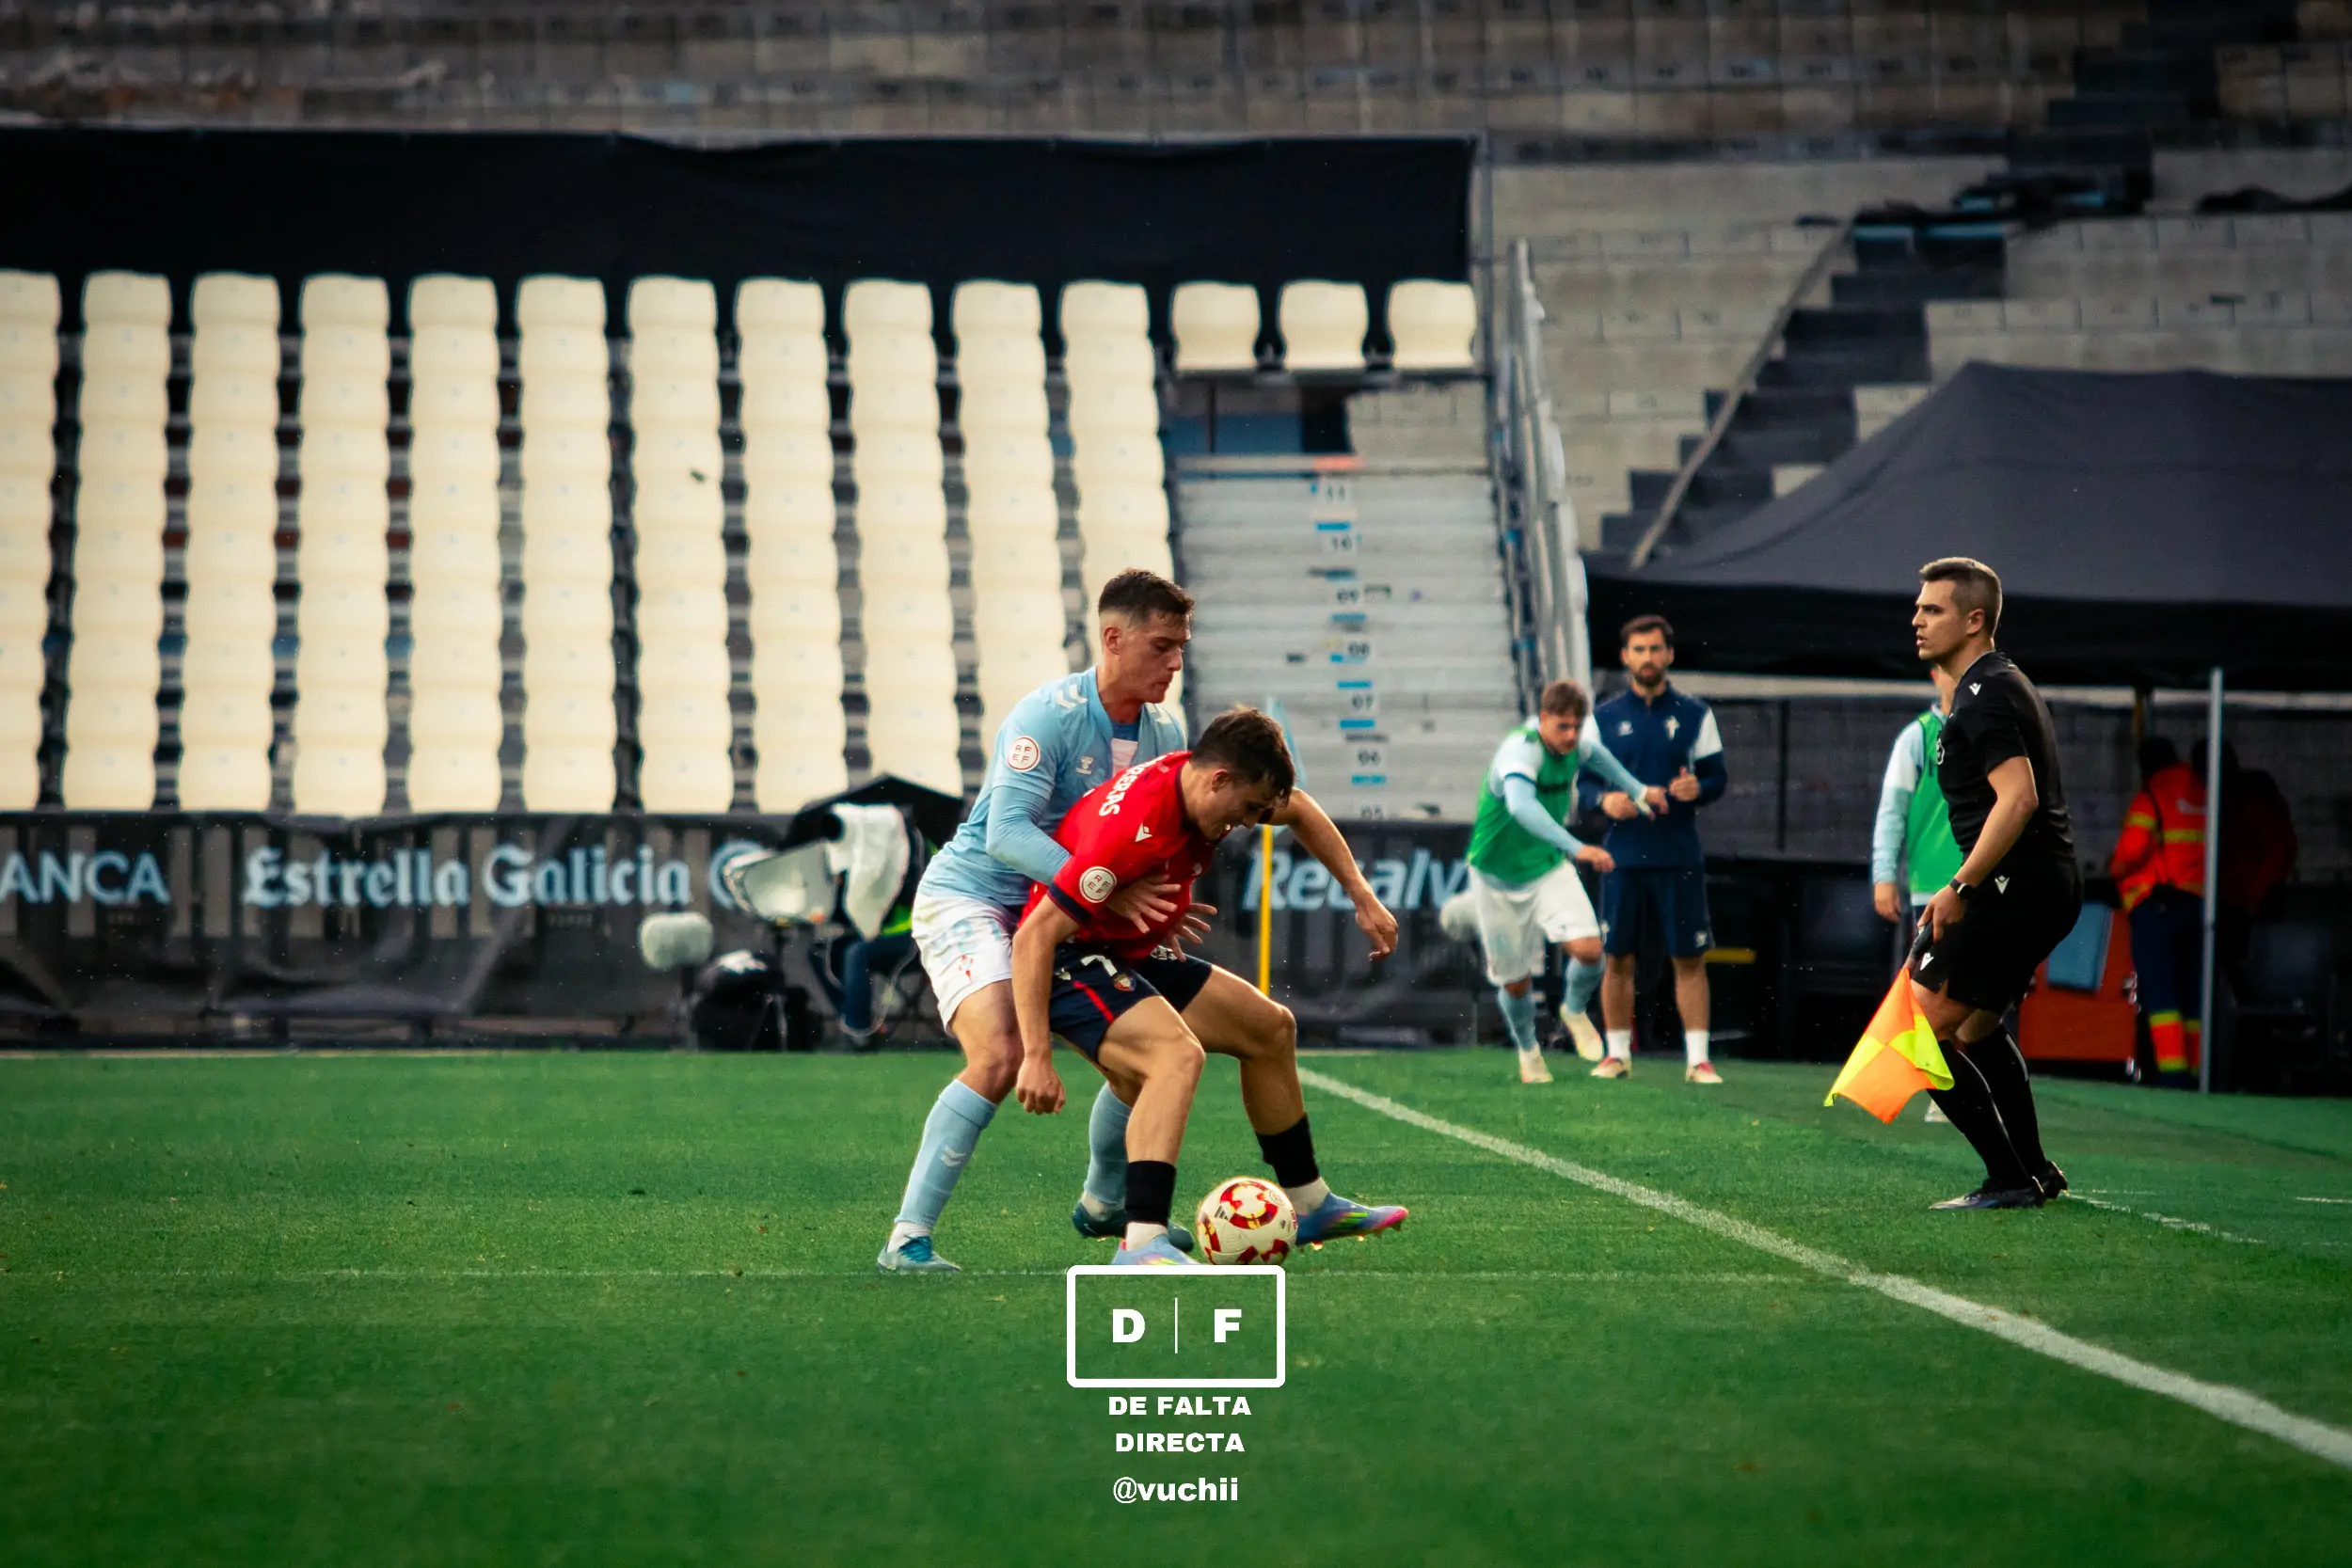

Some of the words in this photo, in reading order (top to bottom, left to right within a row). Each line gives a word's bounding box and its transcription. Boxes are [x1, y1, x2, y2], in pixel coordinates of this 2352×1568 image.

[0, 851, 171, 906] ANCA
[243, 847, 470, 907] Estrella
[481, 845, 691, 908] Galicia
[1080, 954, 1118, 977] 7
